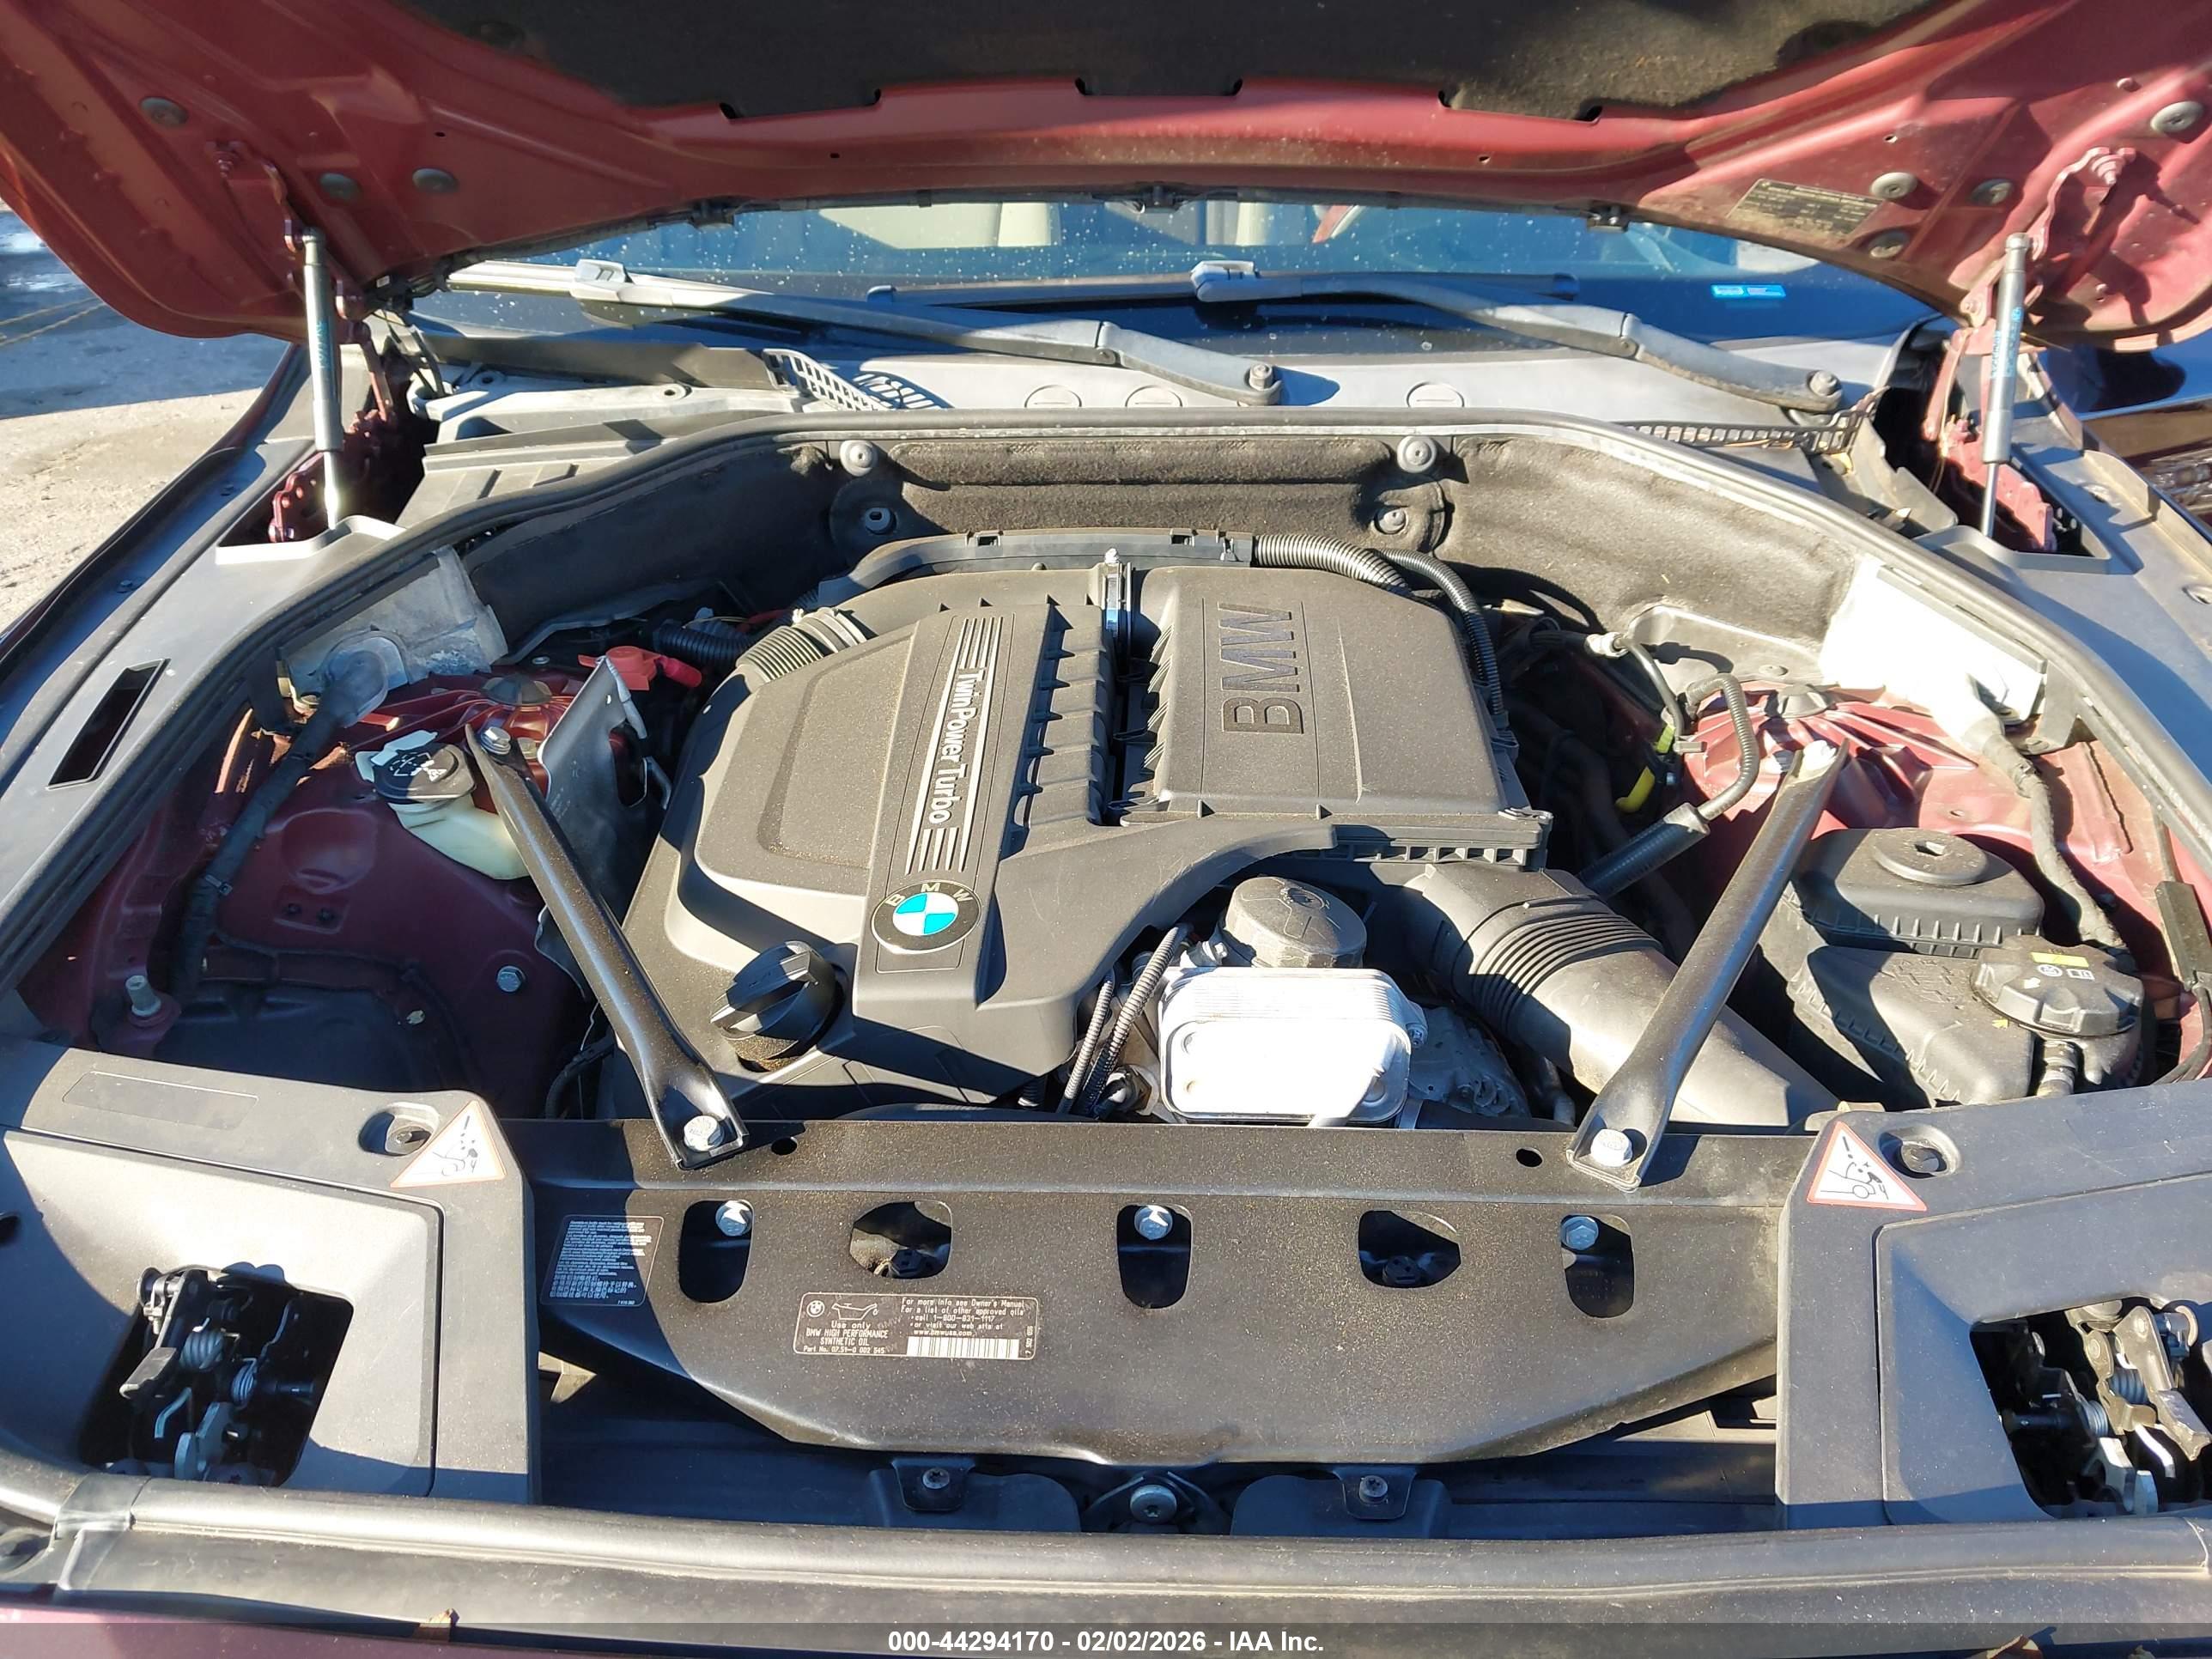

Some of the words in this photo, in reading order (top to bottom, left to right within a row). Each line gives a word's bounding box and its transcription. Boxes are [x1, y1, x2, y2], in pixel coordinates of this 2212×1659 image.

[1217, 601, 1304, 734] BMW
[941, 667, 985, 762] TwinPower
[928, 763, 968, 825] Turbo
[884, 882, 974, 907] BMW
[902, 1297, 914, 1305] For
[938, 1297, 952, 1306] info
[971, 1298, 998, 1307] Owner's
[1000, 1299, 1024, 1308] Manual
[901, 1304, 912, 1313] For
[925, 1305, 938, 1314] list
[975, 1308, 1006, 1316] approved
[831, 1320, 847, 1328] Use
[851, 1321, 872, 1330] only
[806, 1328, 822, 1337] BMW
[824, 1328, 840, 1337] HIGH
[842, 1329, 889, 1339] PERFORMANCE
[820, 1337, 855, 1346] SYNTHETIC
[859, 1338, 870, 1346] OIL
